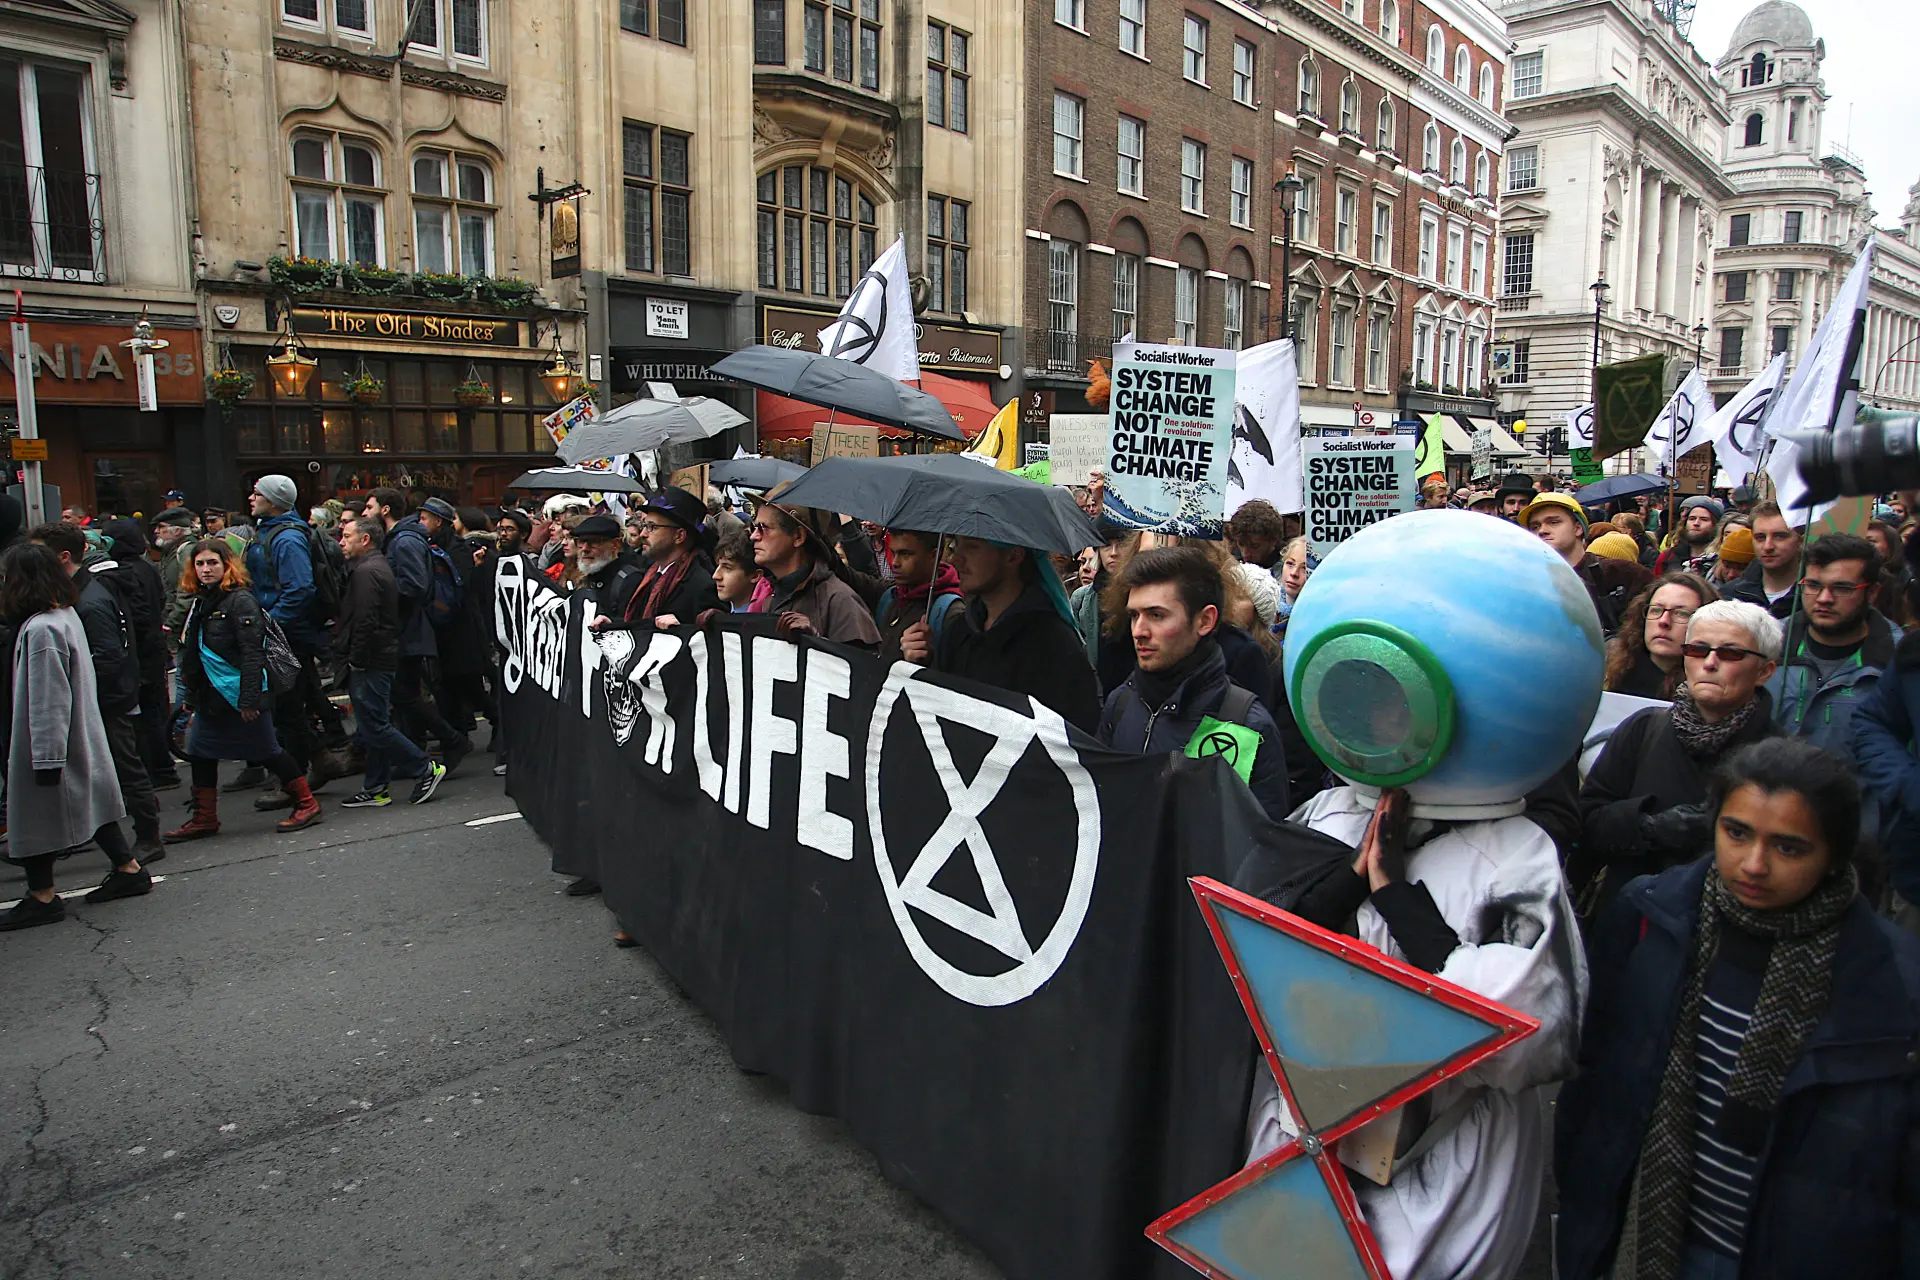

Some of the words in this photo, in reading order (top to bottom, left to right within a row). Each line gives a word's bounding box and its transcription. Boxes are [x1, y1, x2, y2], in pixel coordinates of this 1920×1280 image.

[650, 304, 664, 313] TO
[666, 306, 684, 315] LET
[323, 309, 367, 333] The
[375, 312, 412, 336] Old
[421, 315, 496, 341] Shades
[154, 353, 196, 377] 35
[947, 347, 993, 365] Ristorante
[1134, 349, 1178, 365] Socialist
[1178, 352, 1215, 367] Worker
[1116, 368, 1212, 395] SYSTEM
[1115, 389, 1216, 418] CHANGE
[1433, 402, 1444, 410] THE
[1445, 402, 1472, 413] CLARENCE
[545, 413, 564, 430] WE
[1052, 418, 1087, 430] UNLESS
[1114, 410, 1162, 435] NOT
[1164, 417, 1179, 427] One
[1181, 420, 1214, 430] solution:
[830, 431, 871, 450] THERE
[1069, 435, 1090, 444] cares
[1163, 428, 1202, 438] revolution
[1112, 432, 1214, 462] CLIMATE
[1323, 441, 1361, 452] Socialist
[1361, 440, 1396, 450] Worker
[1051, 459, 1073, 473] going
[1079, 457, 1089, 466] to
[1110, 453, 1210, 482] CHANGE
[1309, 456, 1394, 474] SYSTEM
[400, 474, 417, 488] Old
[1309, 474, 1399, 491] CHANGE
[1310, 492, 1352, 508] NOT
[687, 630, 854, 861] LIFE
